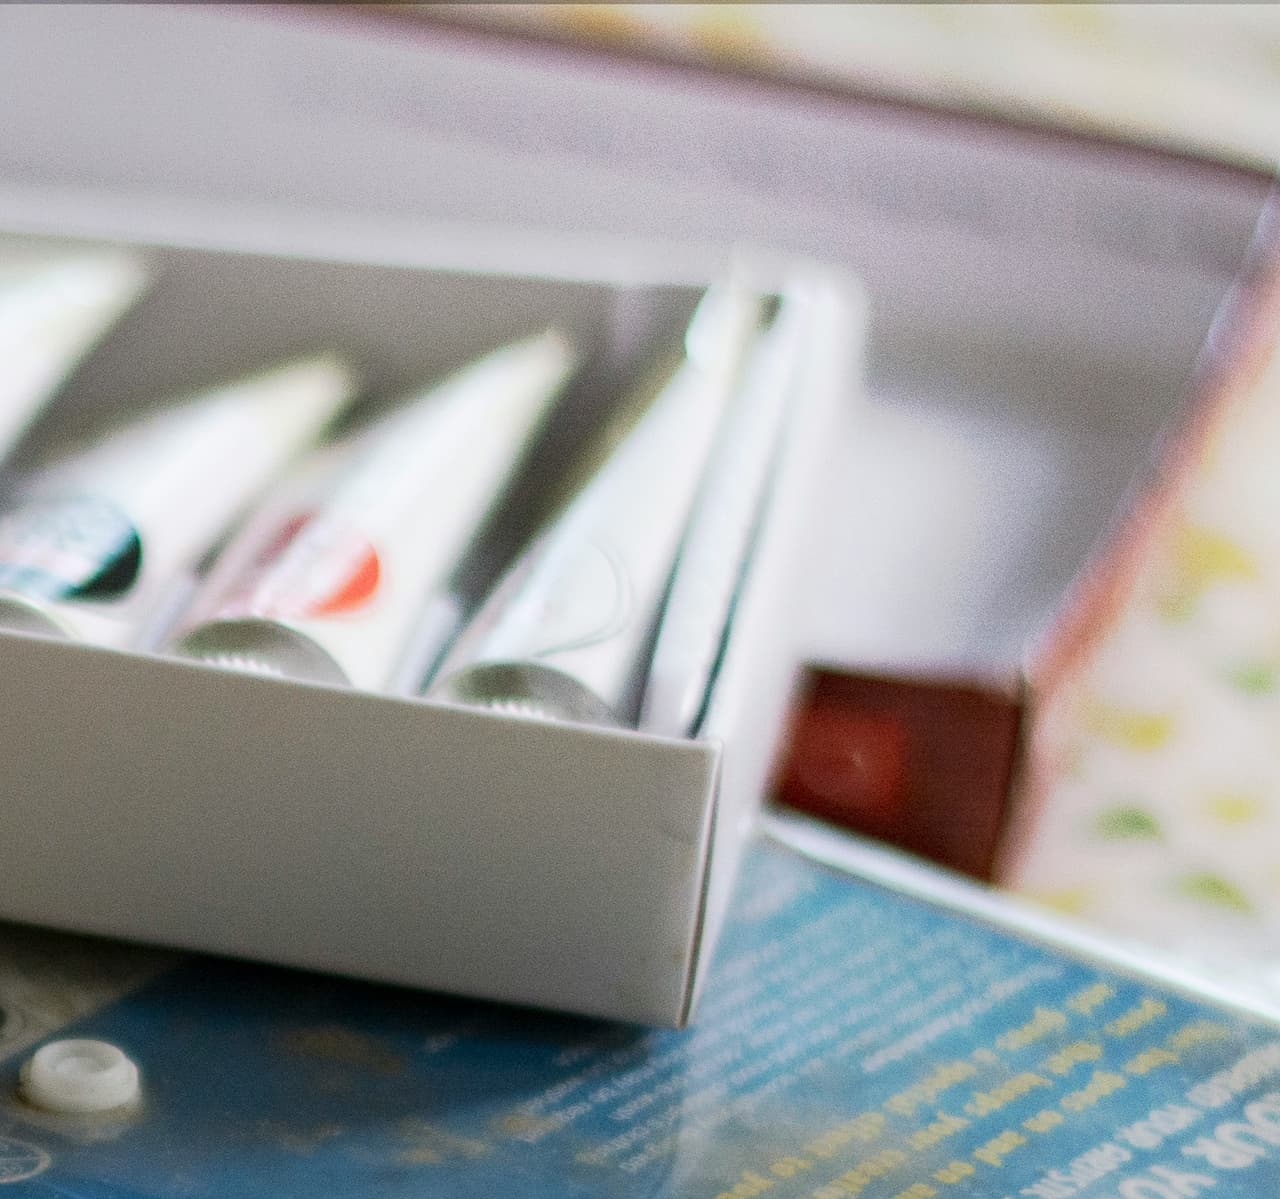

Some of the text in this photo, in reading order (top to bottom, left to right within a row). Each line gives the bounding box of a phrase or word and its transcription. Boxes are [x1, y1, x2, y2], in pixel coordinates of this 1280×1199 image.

[1118, 1104, 1199, 1147] YOUR
[973, 1130, 1026, 1166] and
[771, 1157, 810, 1177] to
[935, 1162, 974, 1183] on
